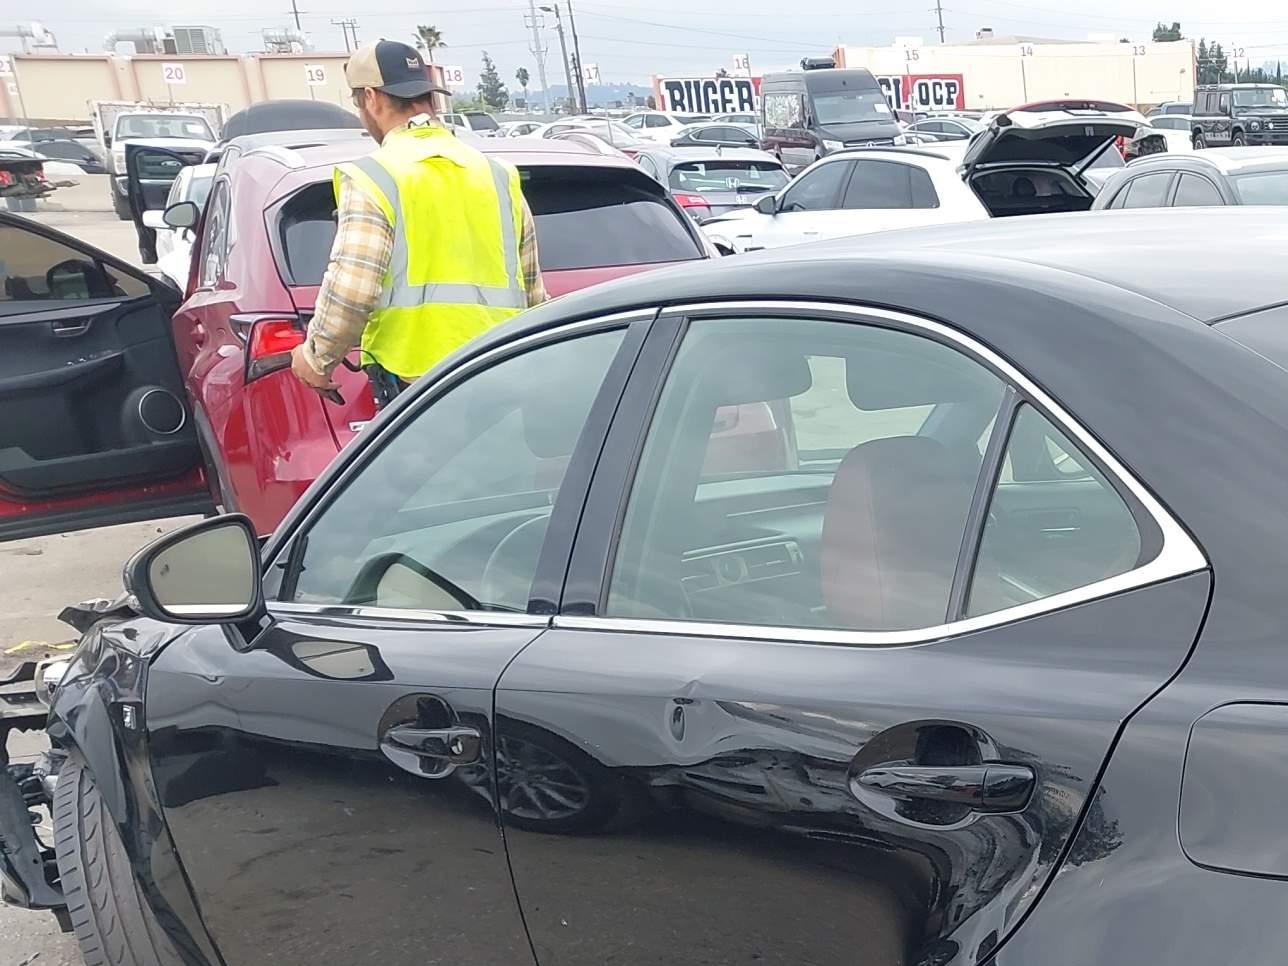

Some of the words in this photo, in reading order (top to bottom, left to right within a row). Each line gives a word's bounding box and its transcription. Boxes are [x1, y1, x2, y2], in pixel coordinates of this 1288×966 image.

[906, 50, 920, 61] 15
[1021, 47, 1033, 57] 14
[1133, 46, 1146, 56] 13
[1233, 48, 1245, 58] 12
[165, 67, 184, 80] 20
[307, 69, 325, 82] 19
[446, 70, 463, 82] 18
[586, 67, 600, 80] 17
